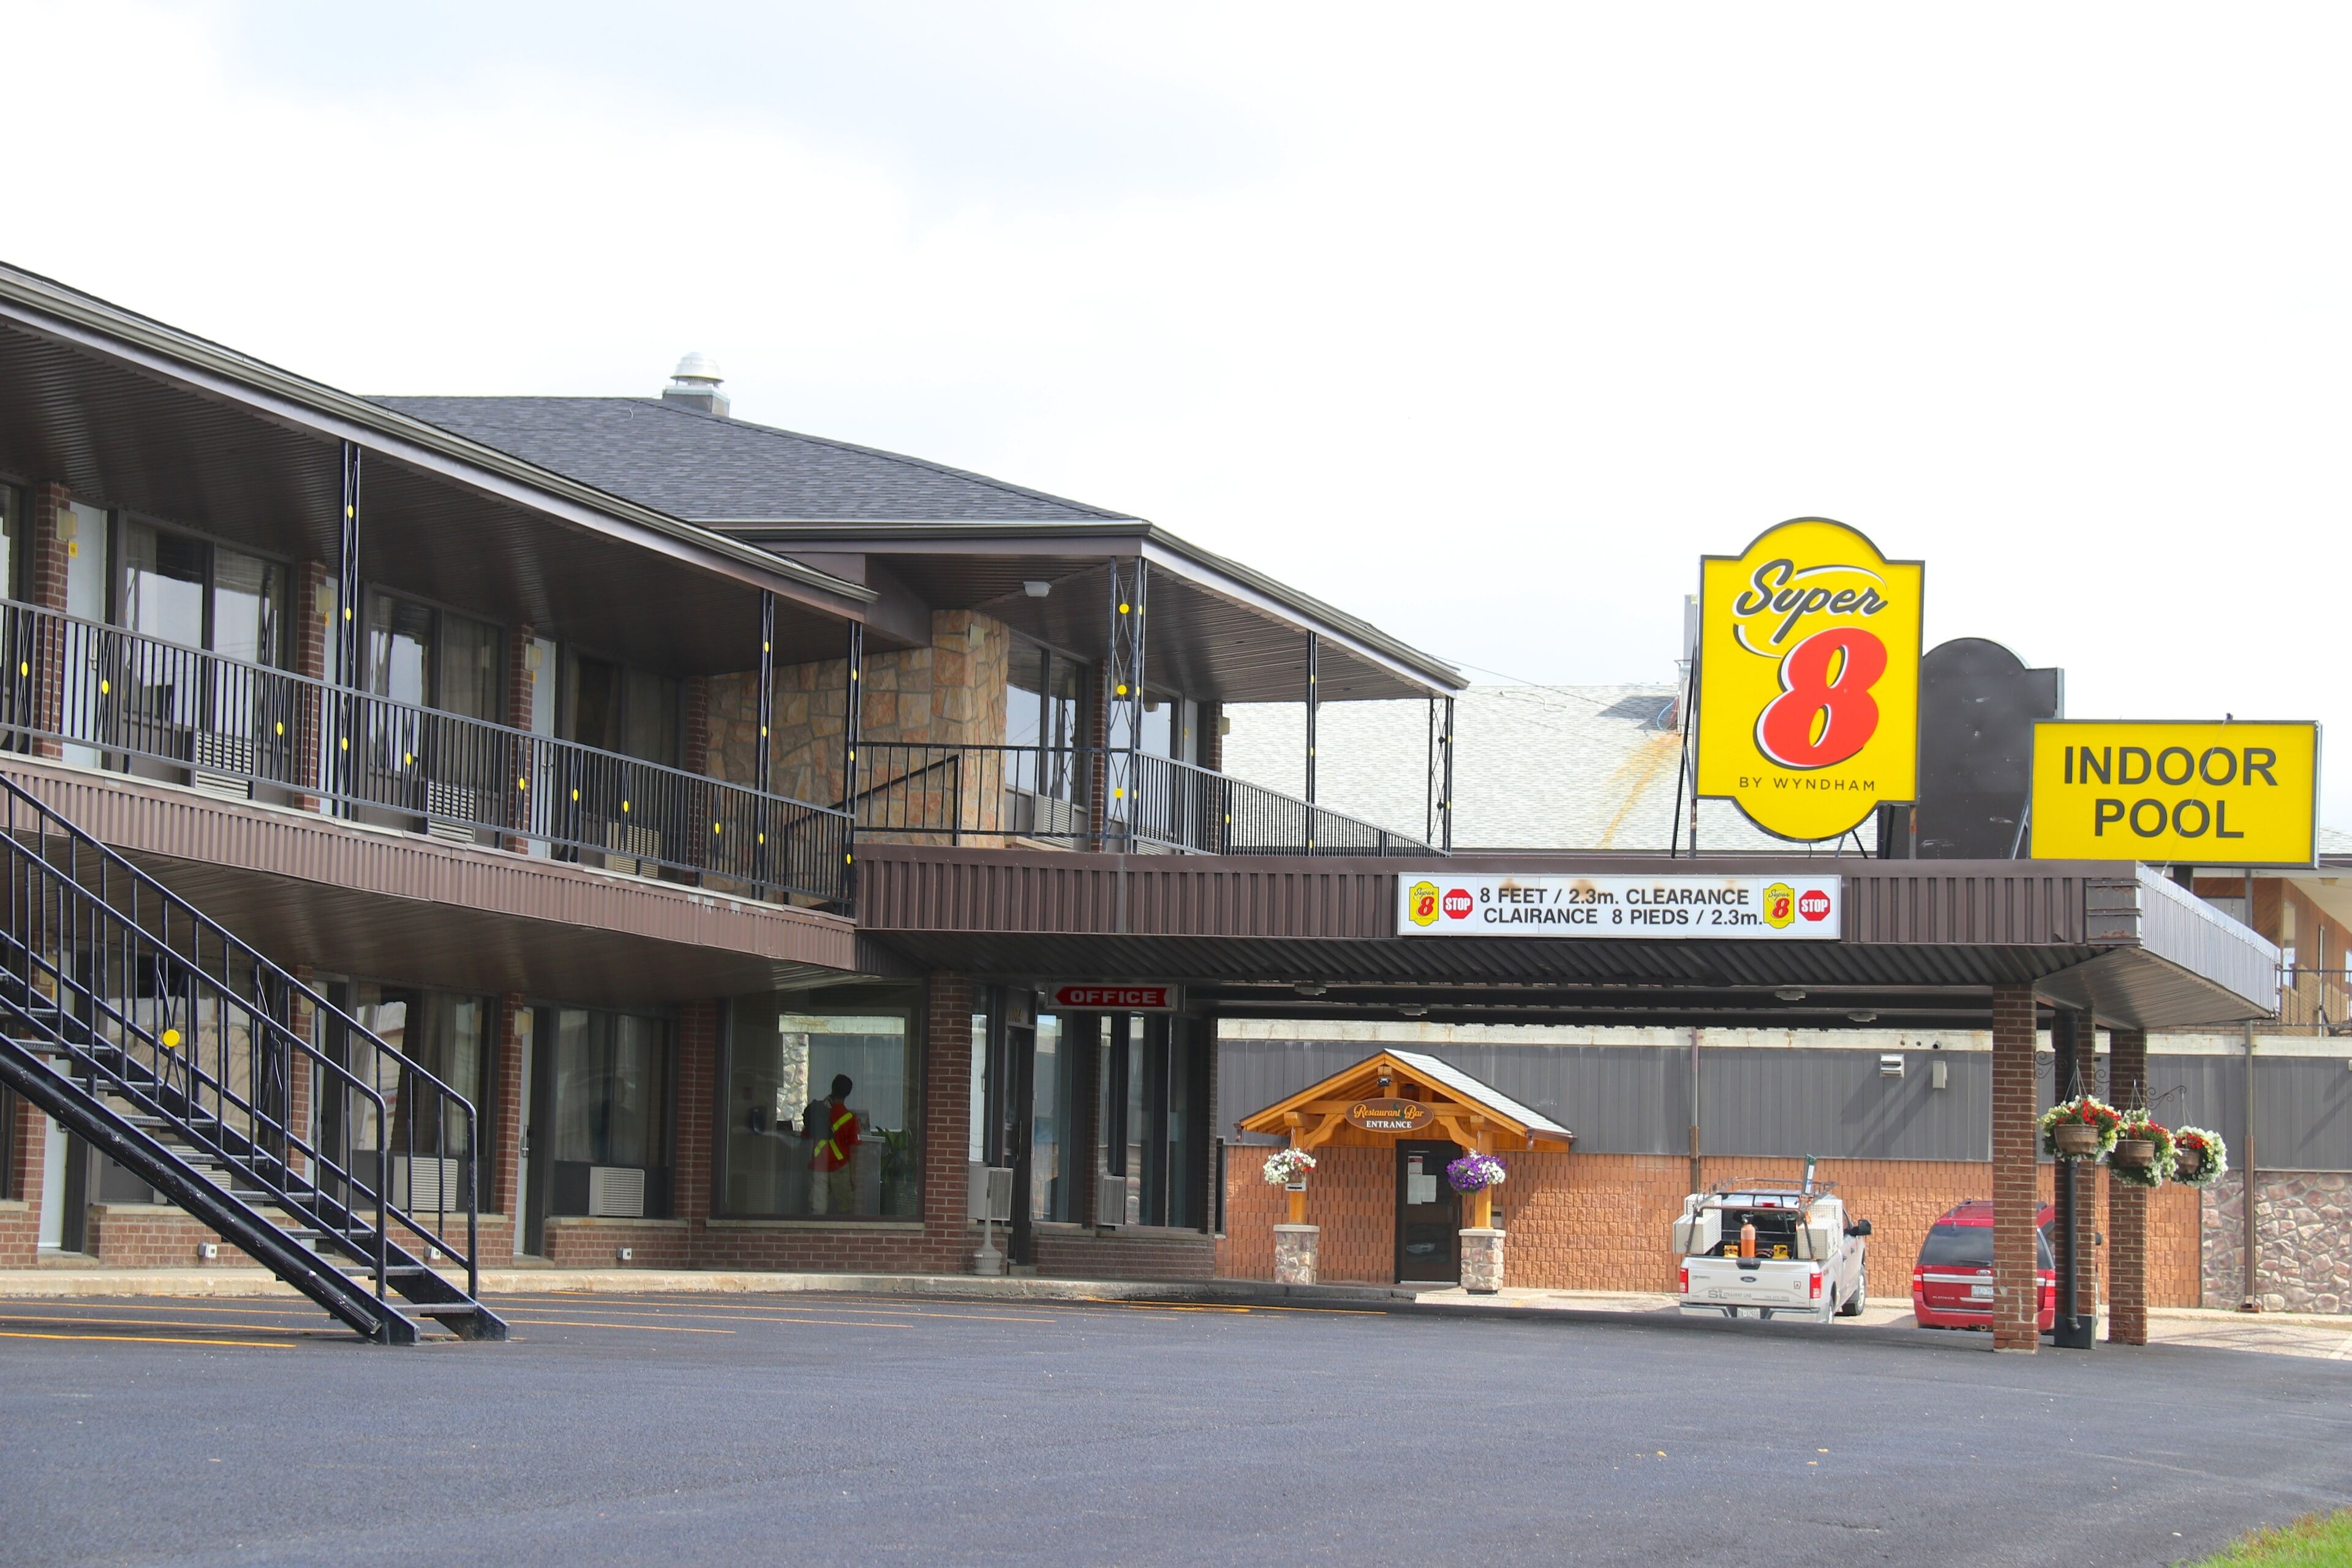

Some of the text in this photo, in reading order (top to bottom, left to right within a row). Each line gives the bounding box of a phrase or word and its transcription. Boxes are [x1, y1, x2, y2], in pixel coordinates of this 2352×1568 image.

[1733, 559, 1888, 646] Super
[1753, 626, 1888, 771] 8
[2064, 745, 2278, 786] INDOOR
[1740, 776, 1875, 791] BY WYNDHAM
[2094, 798, 2244, 838] POOL
[1414, 888, 1435, 899] Super
[1480, 888, 1749, 905] 8 FEET / 2.3m. CLEARANCE
[1768, 889, 1790, 901] Super
[1416, 896, 1434, 916] 8
[1445, 897, 1471, 911] STOP
[1771, 898, 1790, 919] 8
[1801, 899, 1828, 913] STOP
[1483, 908, 1763, 925] CLAIRANCE 8 PIEDS / 2.3m.
[1070, 990, 1157, 1004] OFFICE
[1354, 1104, 1424, 1120] Restaurant Bar
